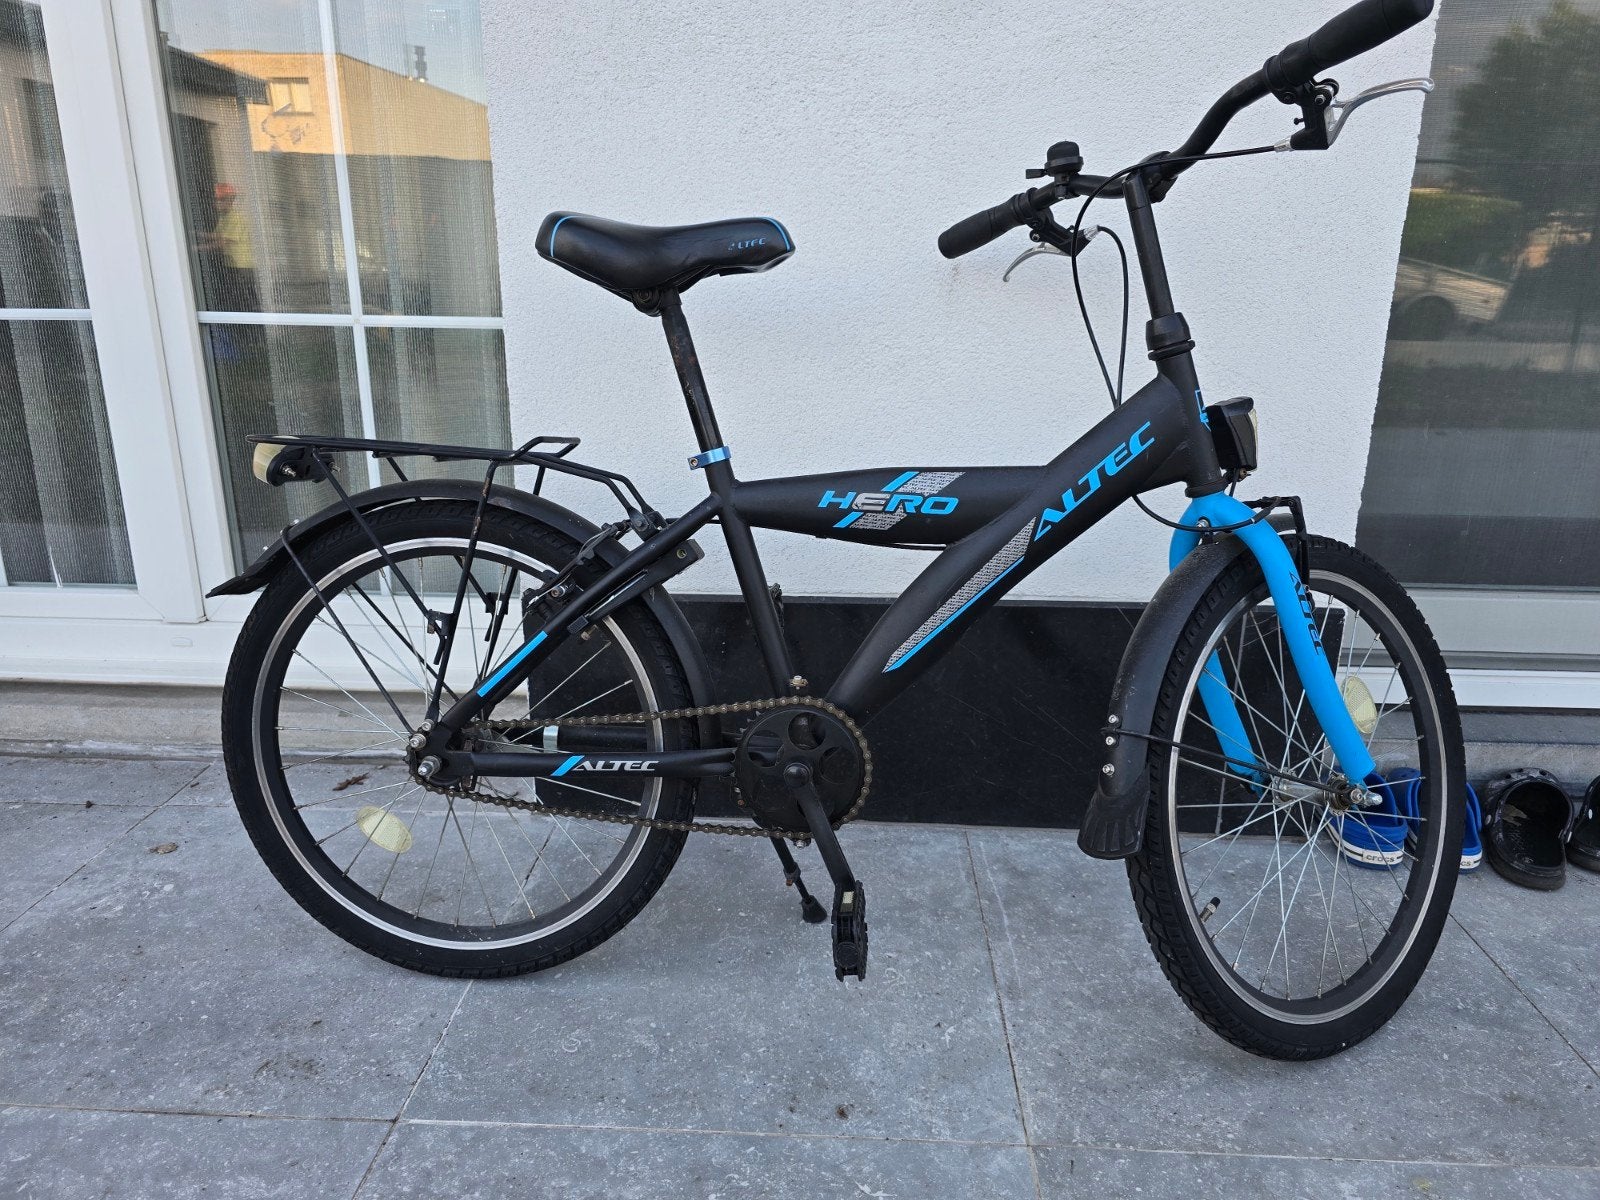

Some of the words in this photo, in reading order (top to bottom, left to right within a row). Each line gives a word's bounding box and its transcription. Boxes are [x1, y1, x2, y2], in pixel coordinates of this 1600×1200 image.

[1034, 420, 1155, 542] ALTEC
[817, 490, 960, 515] HERO
[572, 760, 660, 772] ALTEC
[1366, 854, 1395, 862] crocs
